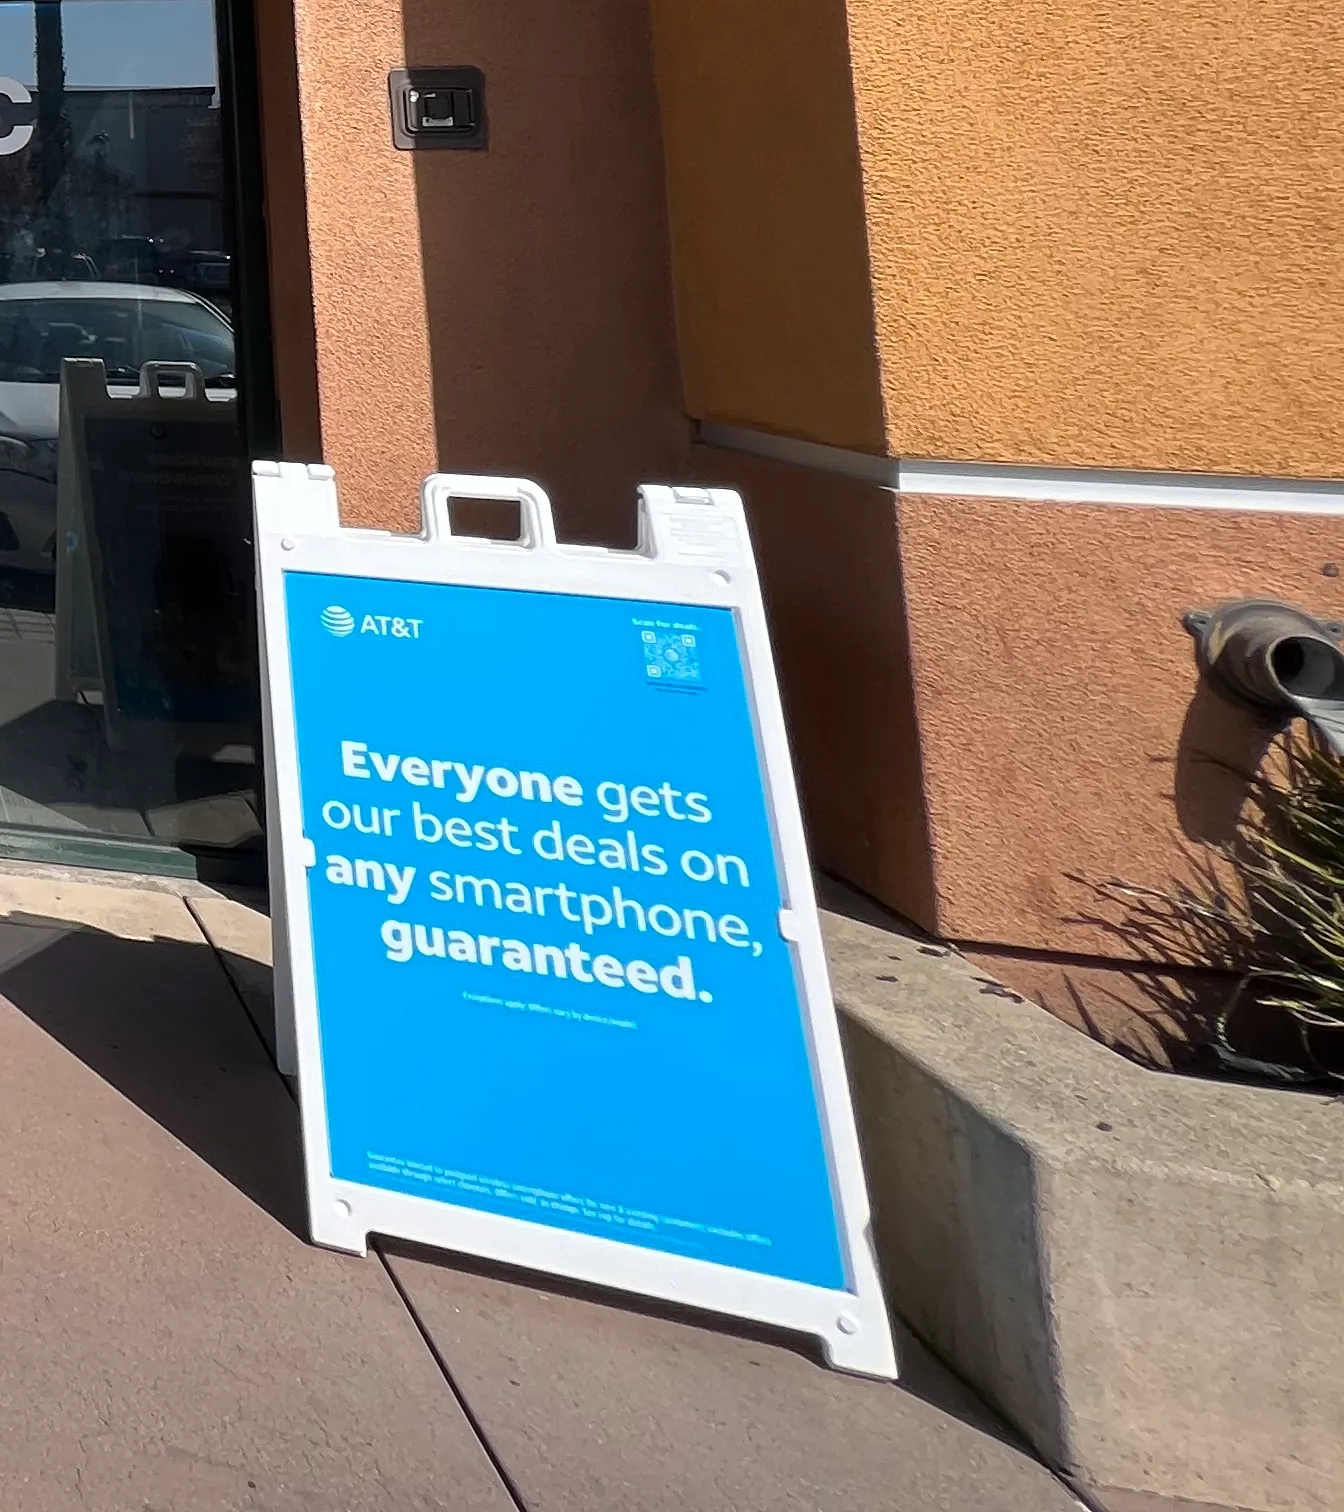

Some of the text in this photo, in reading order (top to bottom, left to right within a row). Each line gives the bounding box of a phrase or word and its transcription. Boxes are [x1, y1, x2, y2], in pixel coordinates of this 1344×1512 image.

[360, 614, 424, 640] AT&T
[340, 739, 713, 826] Everyone gets
[321, 799, 750, 888] our best deals on
[325, 851, 763, 957] any smartphone,
[380, 918, 713, 1004] guaranteed.
